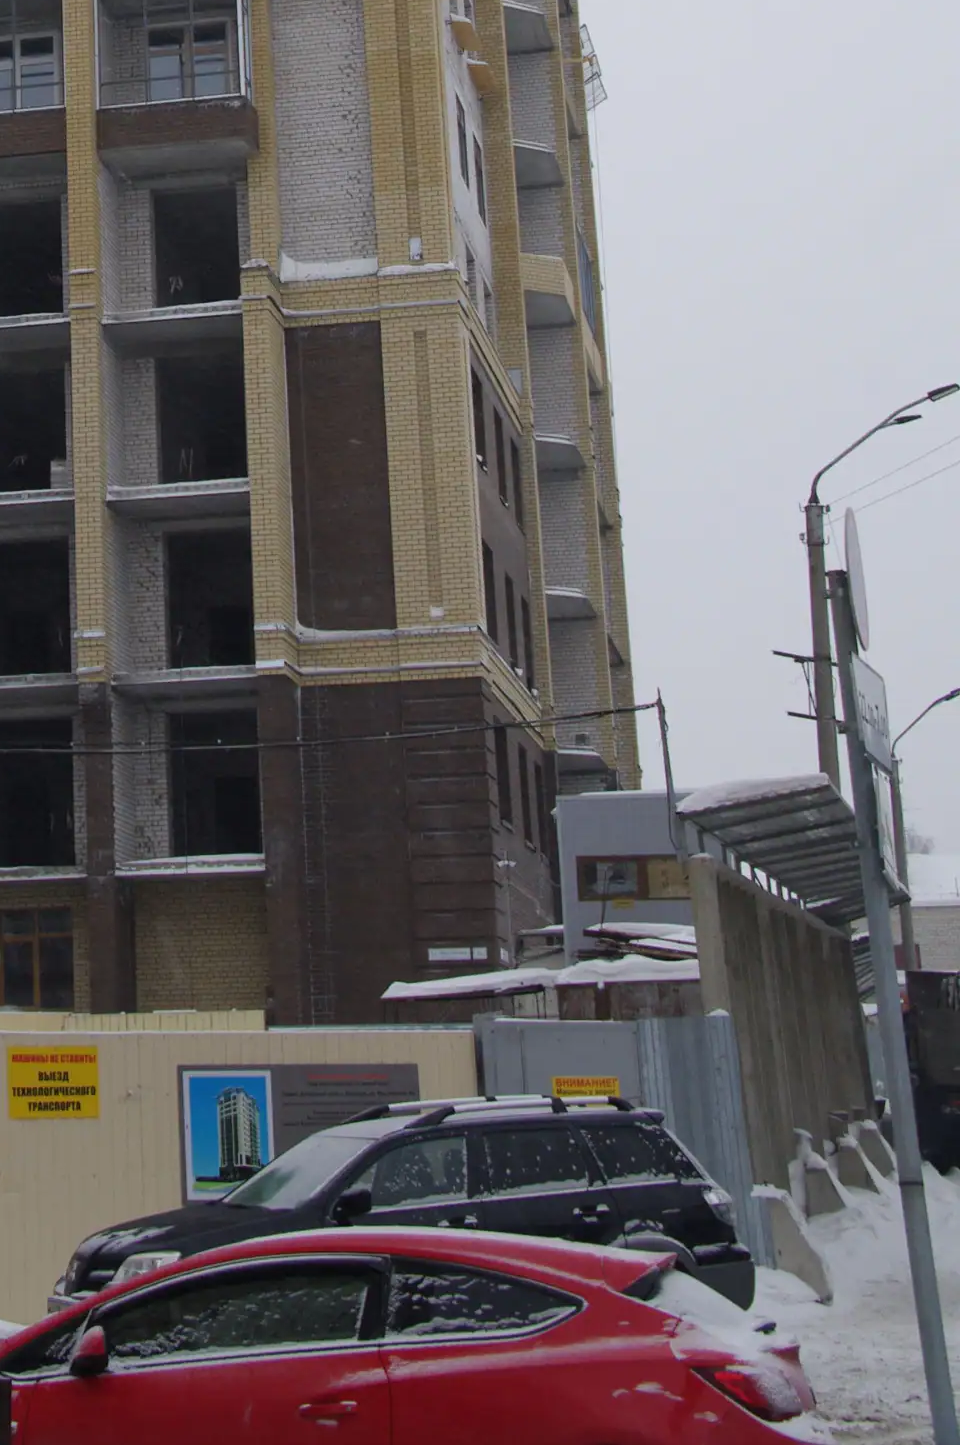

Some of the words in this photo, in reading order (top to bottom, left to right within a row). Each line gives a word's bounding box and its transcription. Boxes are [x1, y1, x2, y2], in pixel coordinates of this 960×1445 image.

[38, 1071, 69, 1083] ВЫЕЗД
[555, 1078, 618, 1088] ВНИМАНИЕ!
[12, 1086, 96, 1097] ТЕХНОЛОГИЧЕСКОГО
[28, 1101, 81, 1112] ТРАНСПОРТА
